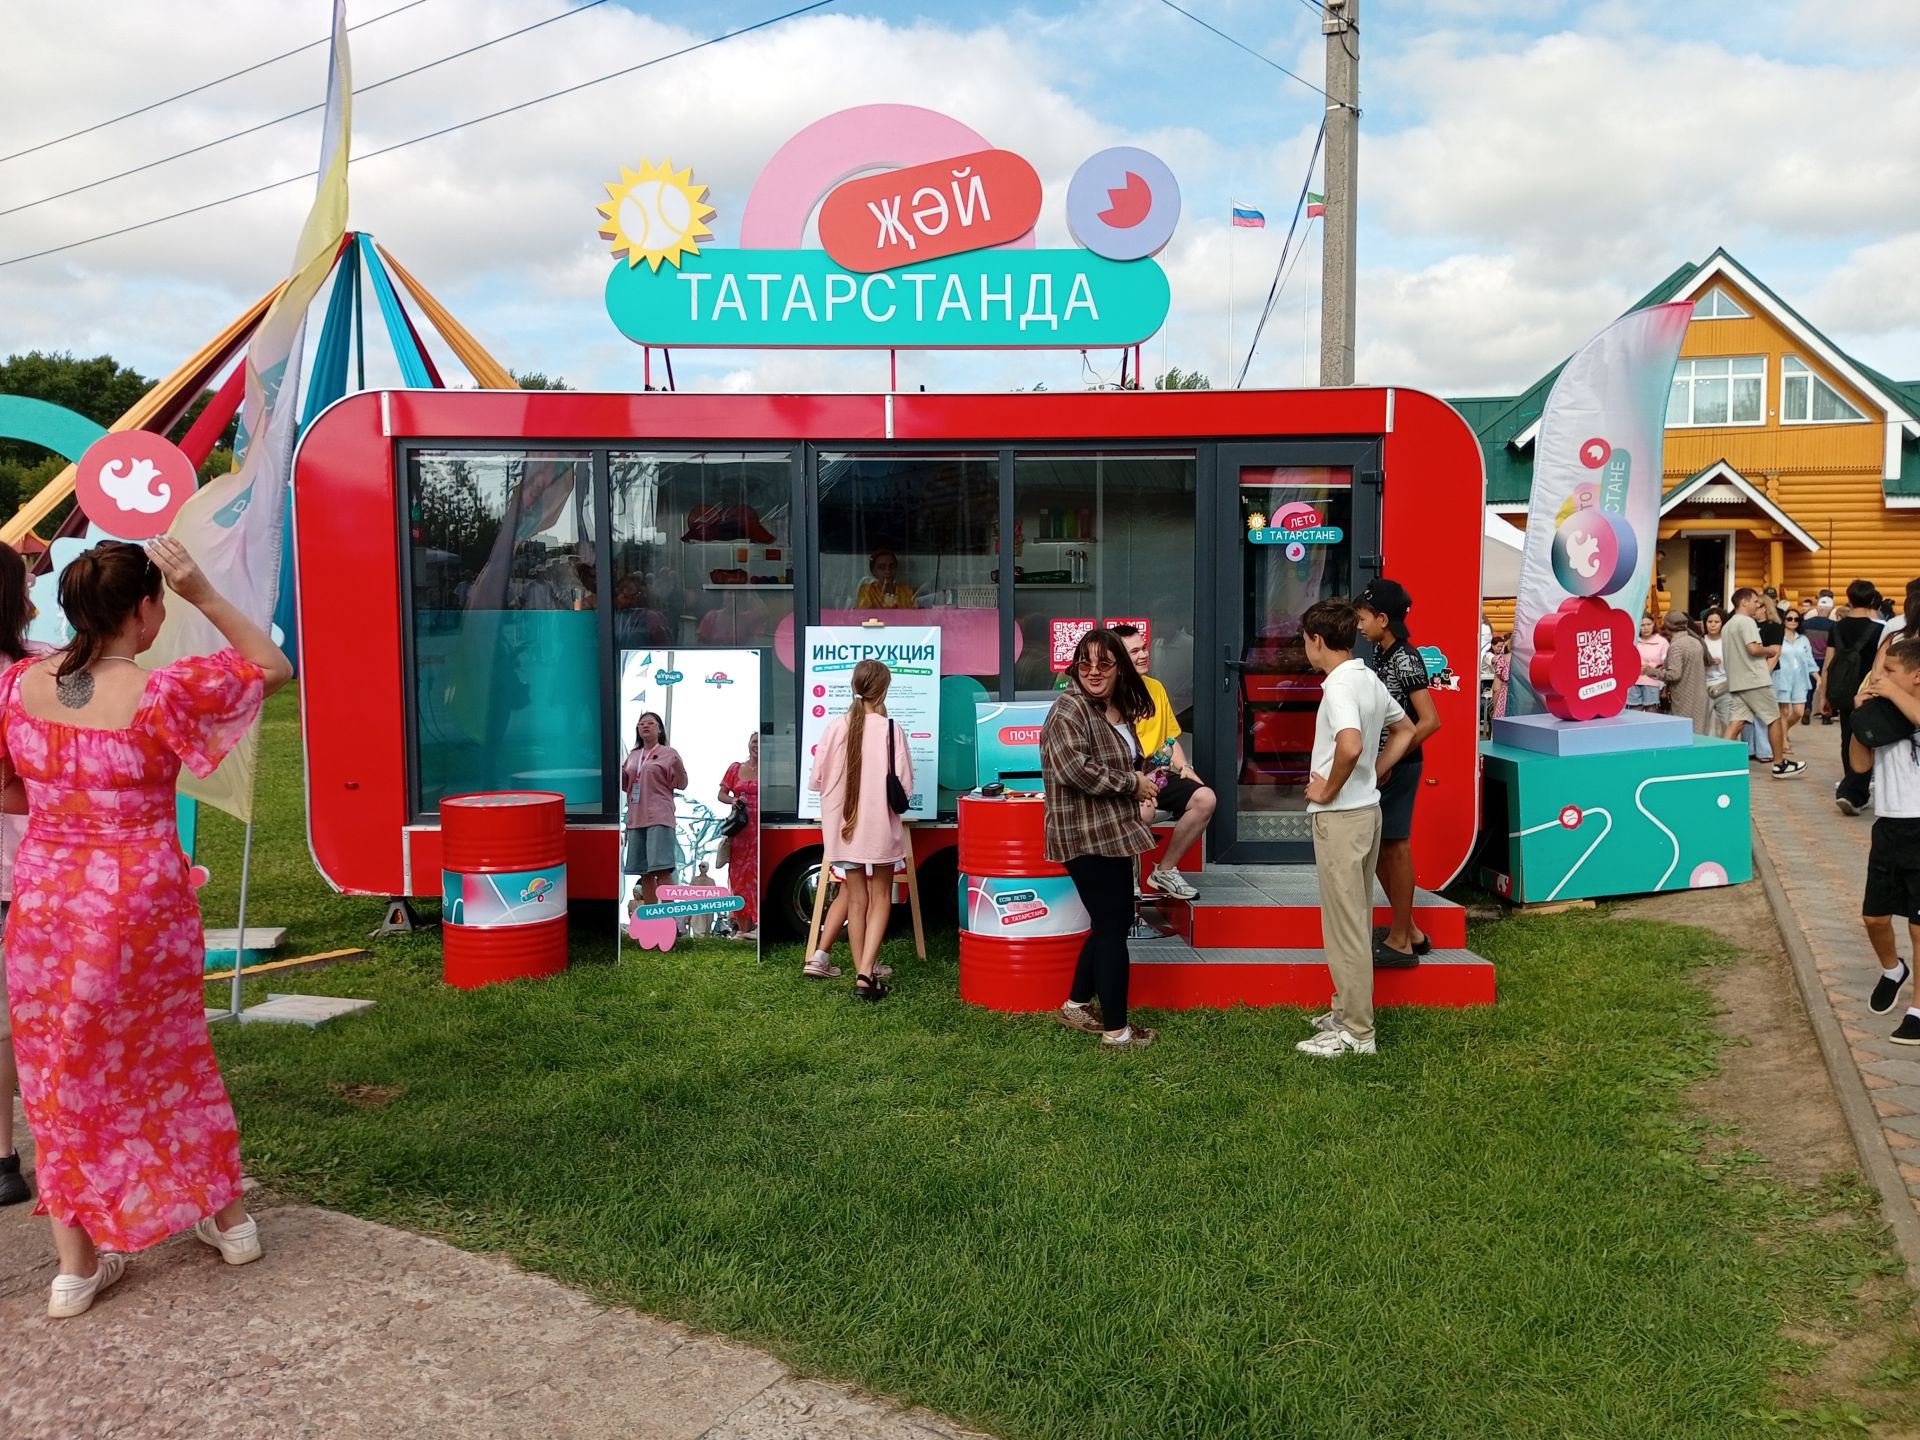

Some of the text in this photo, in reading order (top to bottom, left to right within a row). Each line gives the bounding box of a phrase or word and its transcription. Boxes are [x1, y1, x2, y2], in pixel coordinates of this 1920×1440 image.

[866, 165, 992, 251] ҖӘЙ
[676, 272, 1100, 331] ТАТАРСТАНДА
[1291, 514, 1317, 528] ЛЕТО
[1255, 530, 1335, 540] В ТАТАРСТАНЕ
[812, 644, 935, 664] ИНСТРУКЦИЯ
[1009, 729, 1042, 741] ПОЧТ
[665, 888, 720, 897] ТАТАРСТАН
[645, 900, 736, 917] КАК ОБРАЗ ЖИЗНИ
